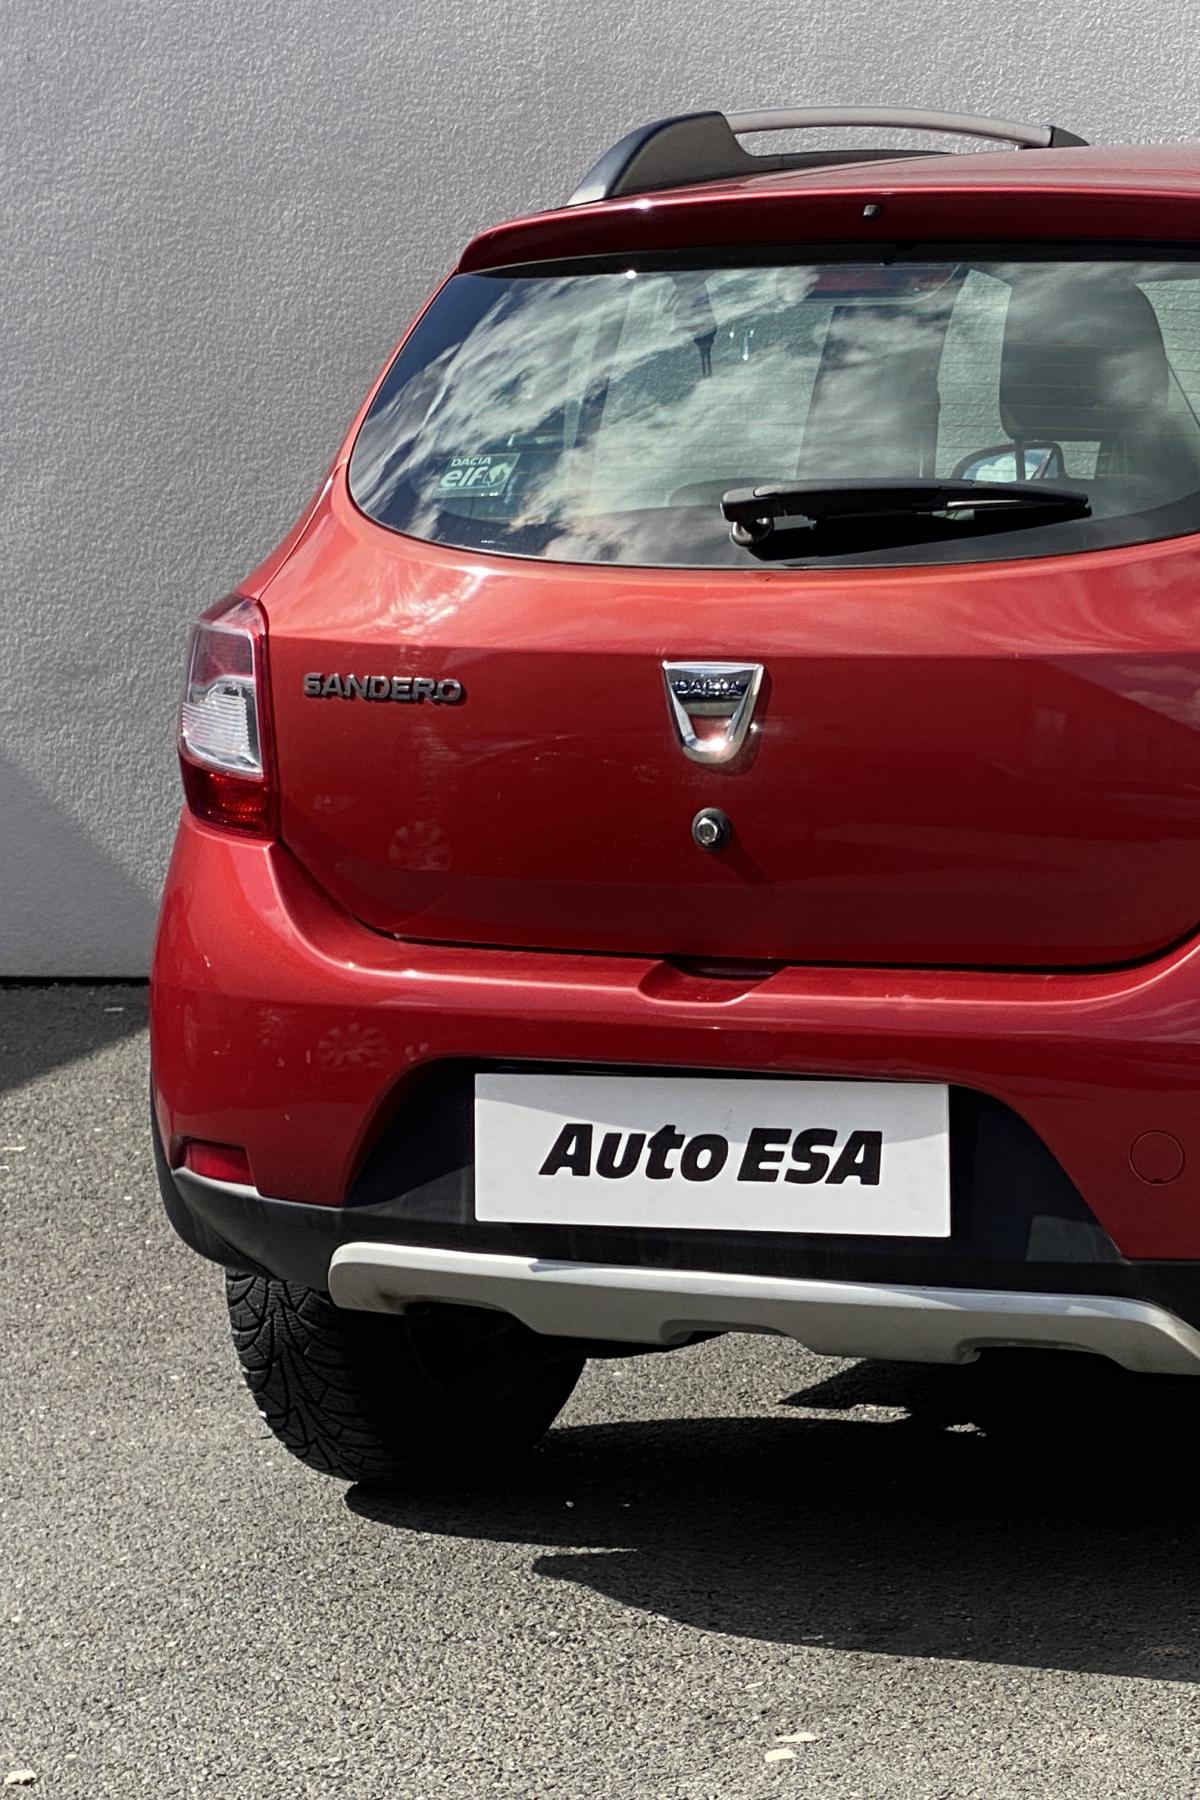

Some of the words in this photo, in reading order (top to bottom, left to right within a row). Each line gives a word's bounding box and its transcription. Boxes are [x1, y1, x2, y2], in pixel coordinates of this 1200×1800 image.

[450, 456, 491, 467] DACIA
[440, 466, 488, 488] elf
[303, 672, 462, 702] SANDERO
[673, 679, 742, 696] DACIA
[538, 1123, 729, 1182] Auto
[737, 1127, 883, 1186] ESA
